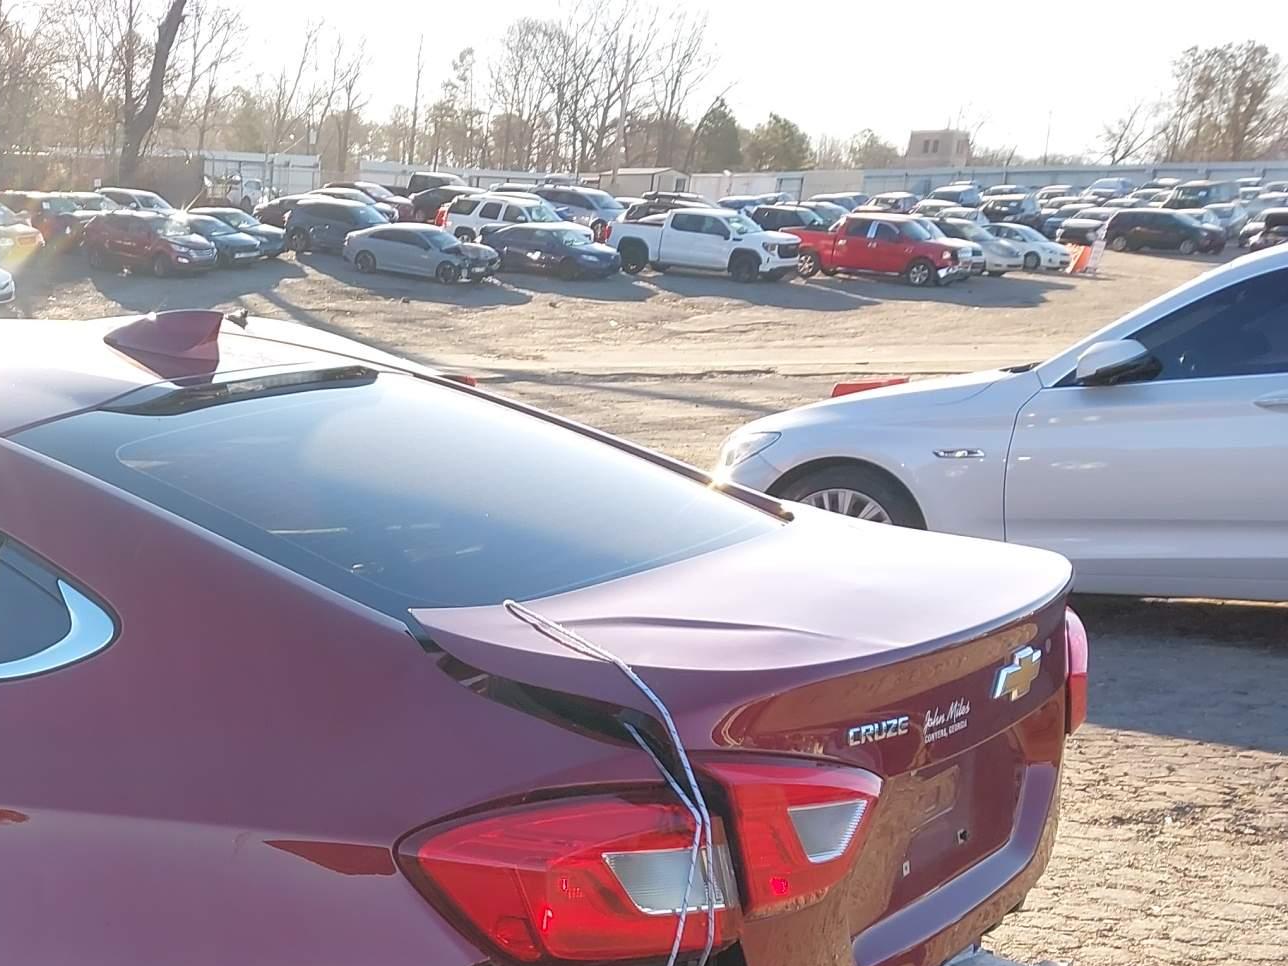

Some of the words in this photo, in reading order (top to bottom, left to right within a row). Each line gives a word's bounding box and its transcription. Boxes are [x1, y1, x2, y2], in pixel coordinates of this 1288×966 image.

[848, 716, 909, 747] CRUZE
[923, 705, 945, 735] John
[946, 697, 970, 723] Miles
